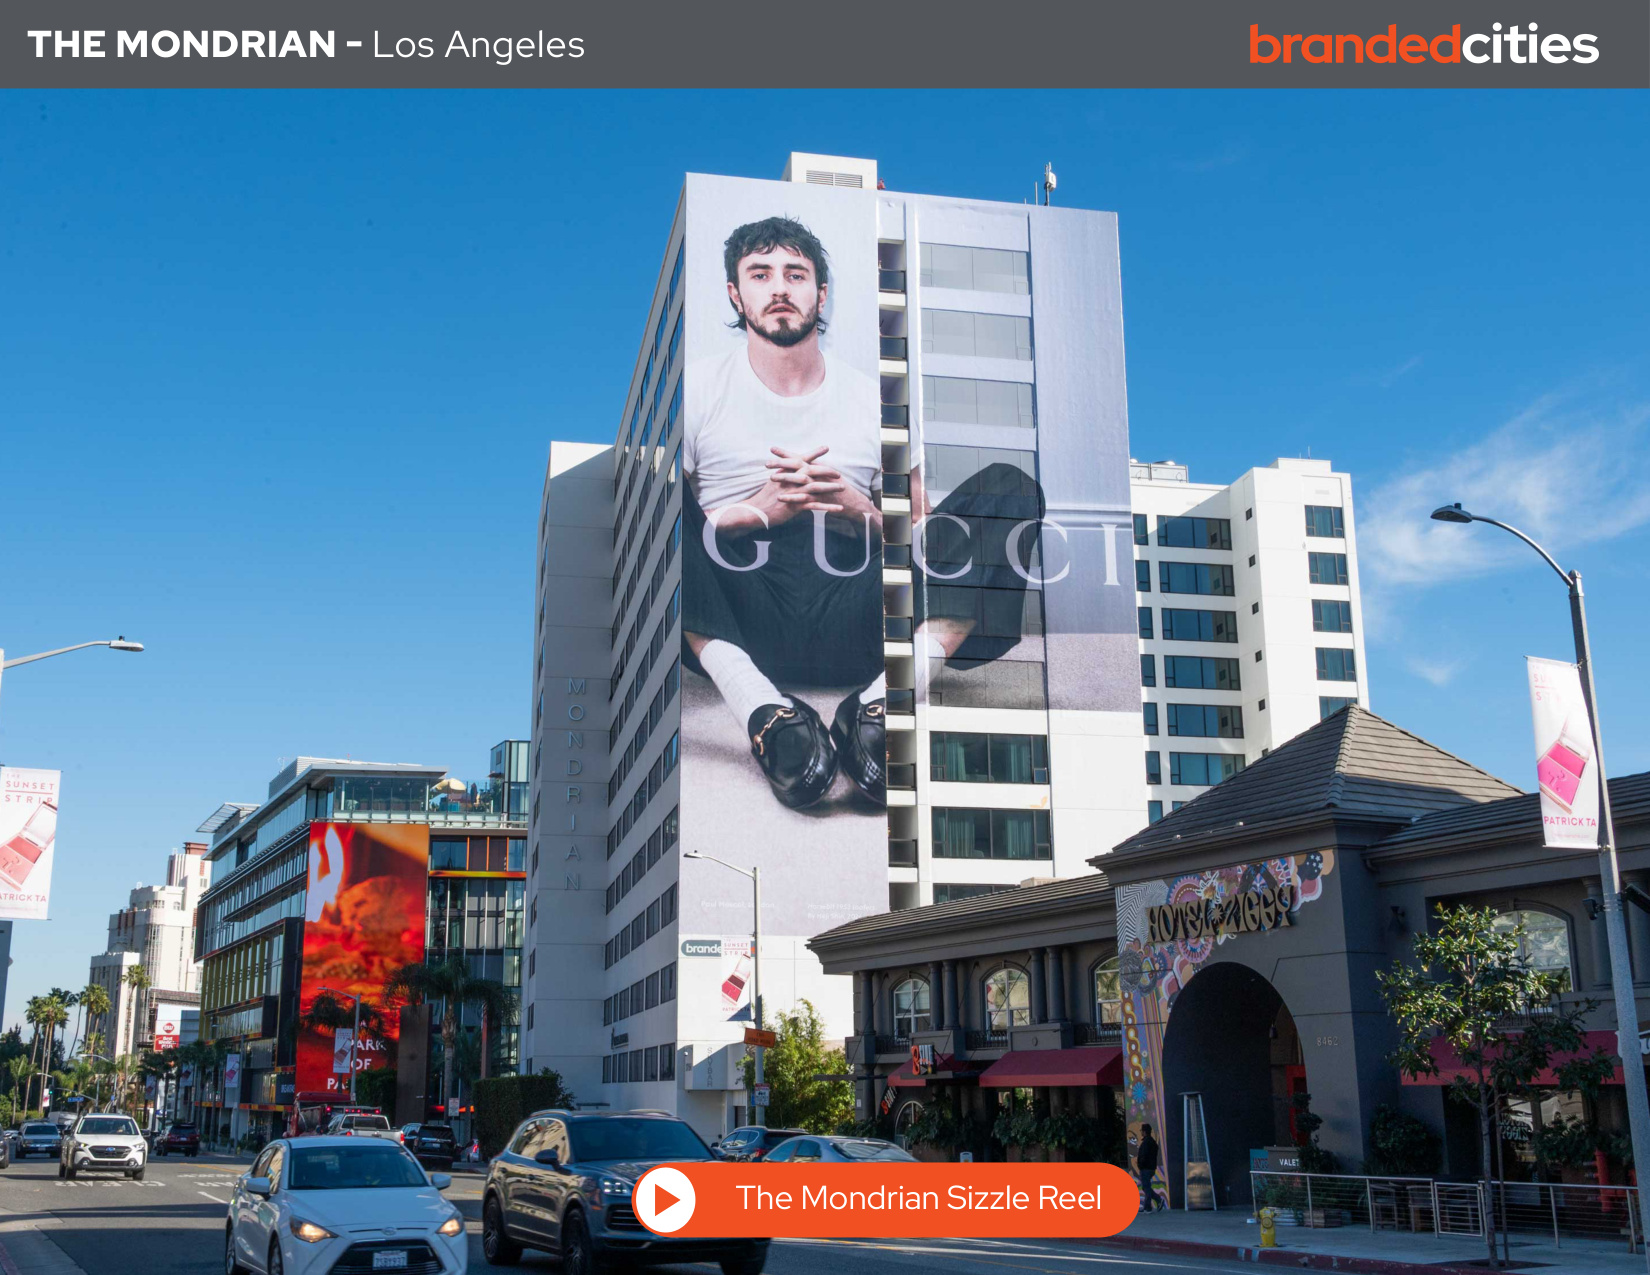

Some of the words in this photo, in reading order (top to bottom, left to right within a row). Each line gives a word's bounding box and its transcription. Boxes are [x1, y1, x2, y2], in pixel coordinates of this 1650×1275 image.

[702, 502, 1121, 587] GUCCI
[6, 780, 55, 790] SUNSET
[564, 677, 586, 891] MONDRIAN
[5, 794, 53, 804] STRIP
[1544, 816, 1584, 826] PATRICK
[1585, 817, 1597, 827] TA
[1146, 897, 1215, 943] HOTEL
[1223, 885, 1295, 931] ZIGGY
[686, 943, 722, 954] brande
[1316, 1036, 1339, 1047] 8462
